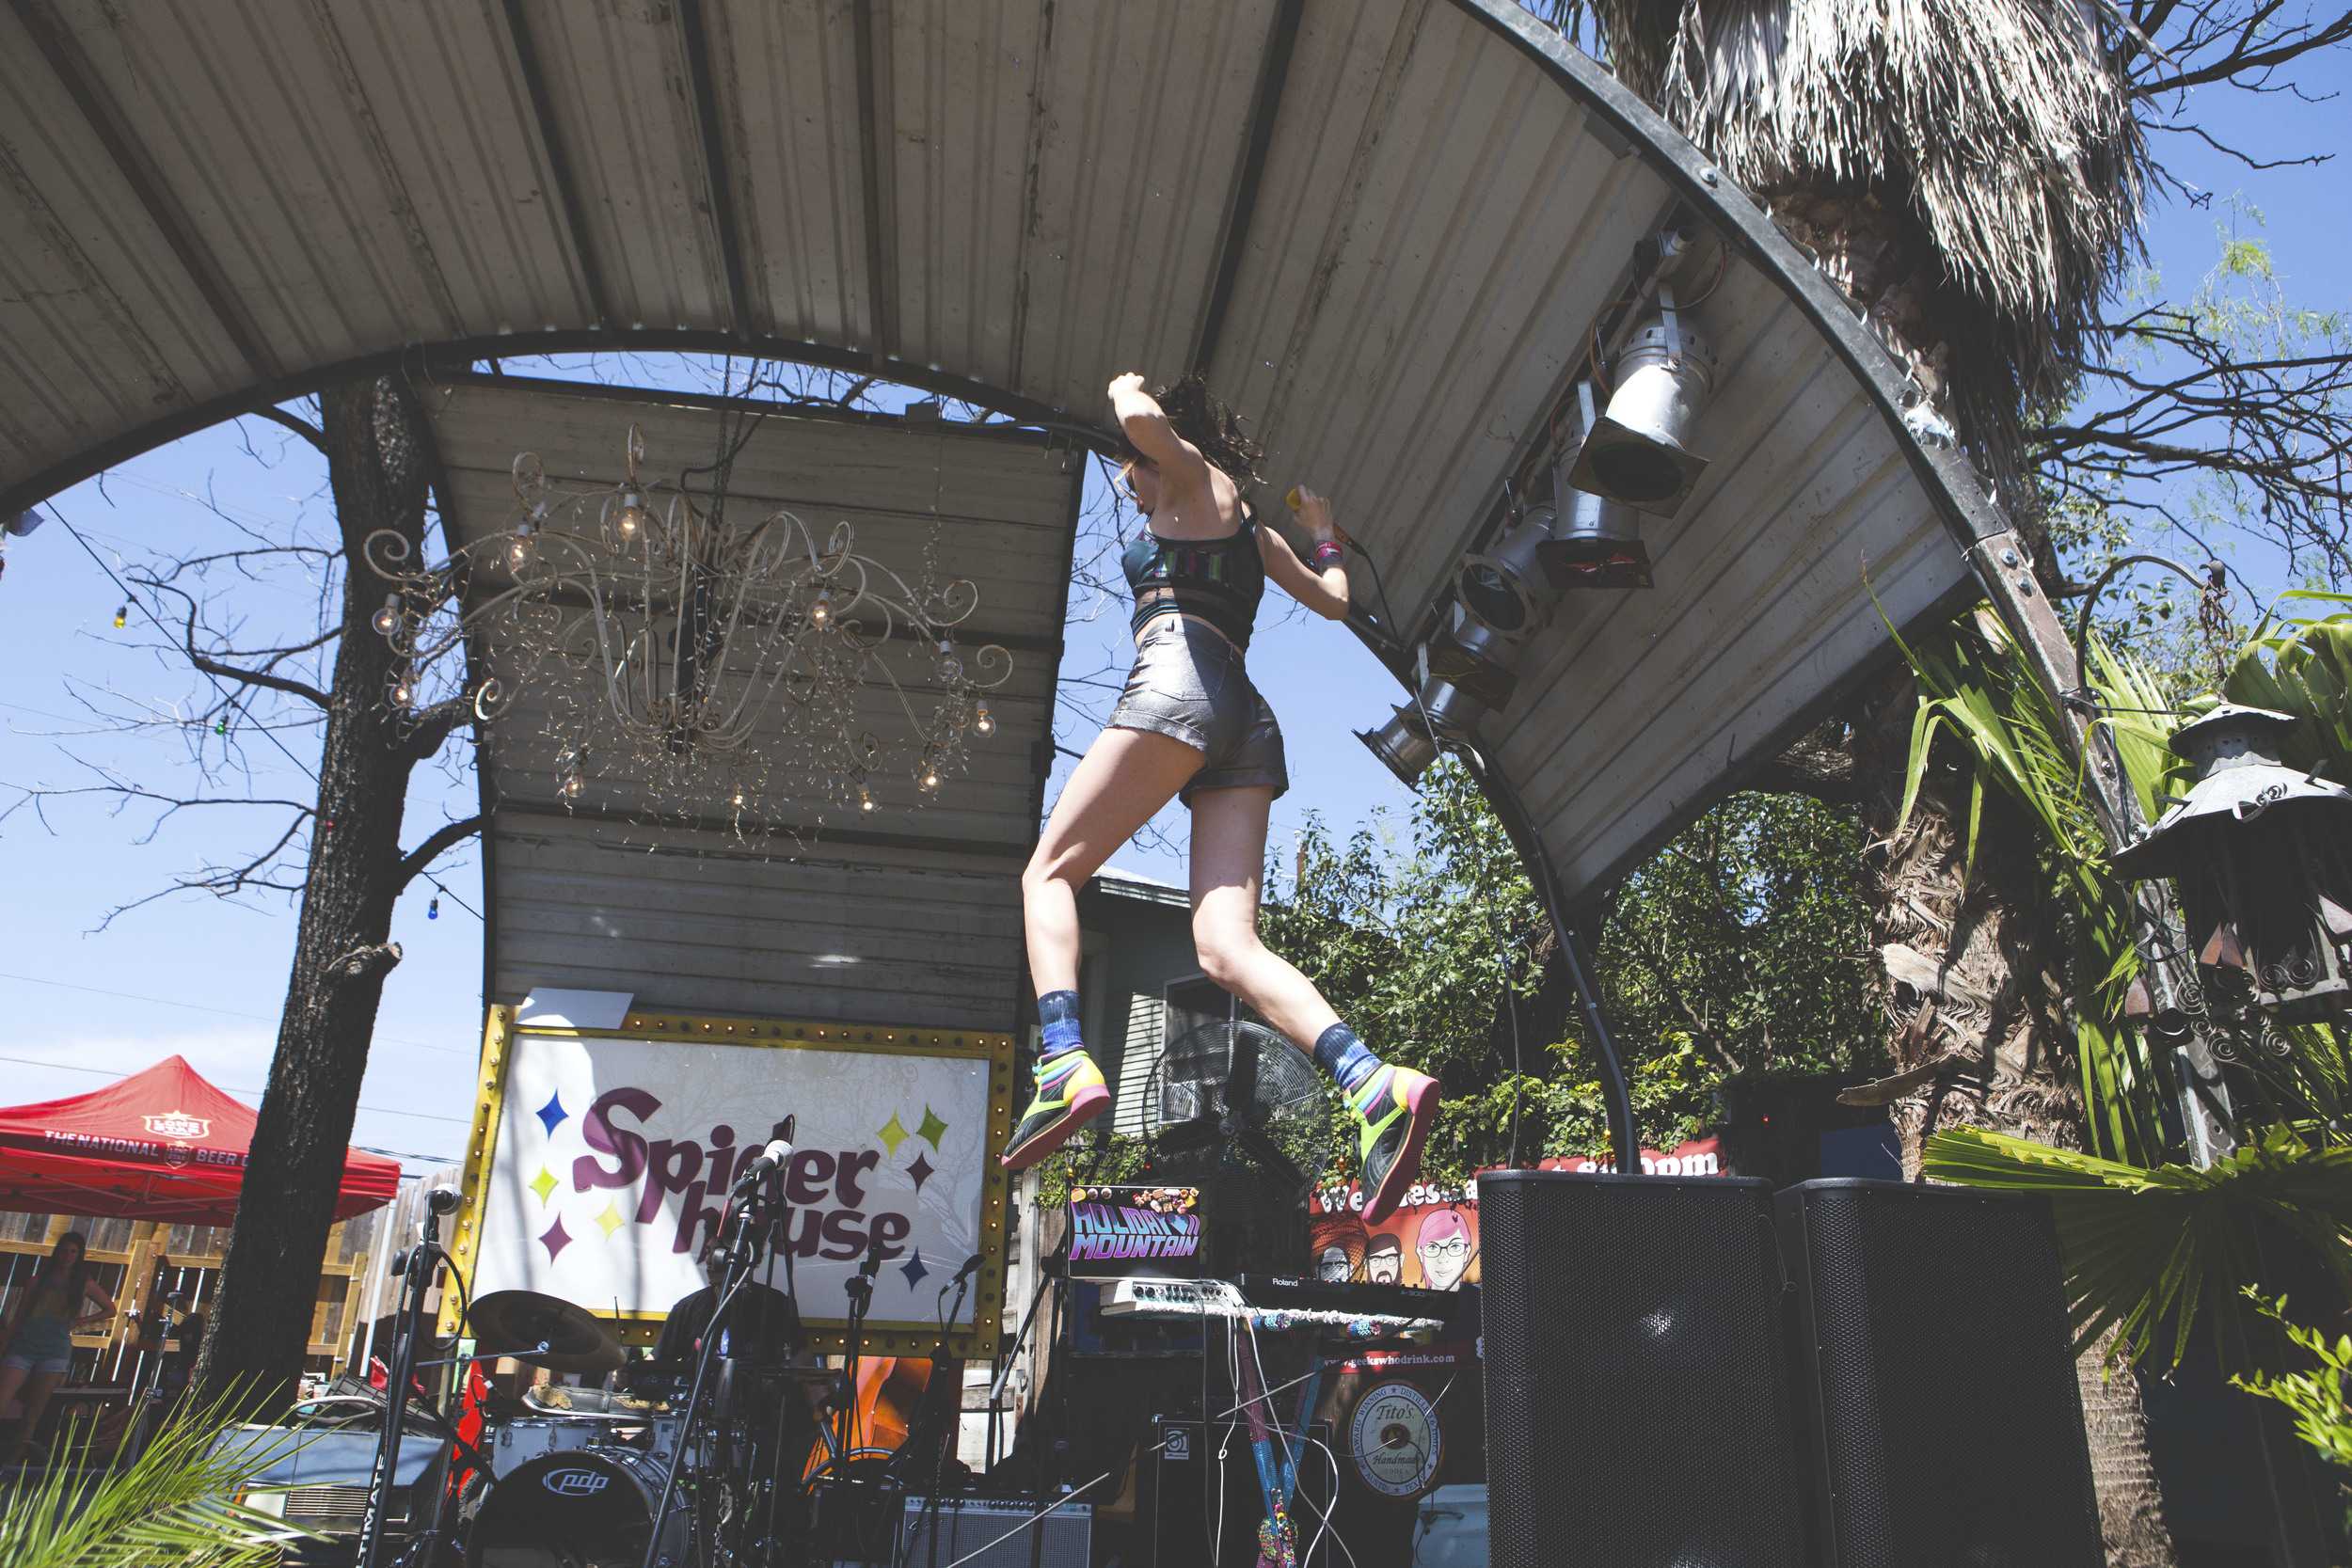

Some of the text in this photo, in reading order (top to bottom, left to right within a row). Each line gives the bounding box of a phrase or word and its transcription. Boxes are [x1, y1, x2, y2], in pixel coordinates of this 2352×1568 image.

[45, 1131, 77, 1146] THE
[76, 1134, 158, 1157] NATIONAL
[196, 1148, 237, 1165] BEER
[673, 1180, 911, 1264] huse
[1071, 1201, 1172, 1235] HOLIDAY
[1069, 1233, 1199, 1260] MOUNTAIN
[1272, 1277, 1298, 1287] Roland
[558, 1471, 610, 1494] pdp
